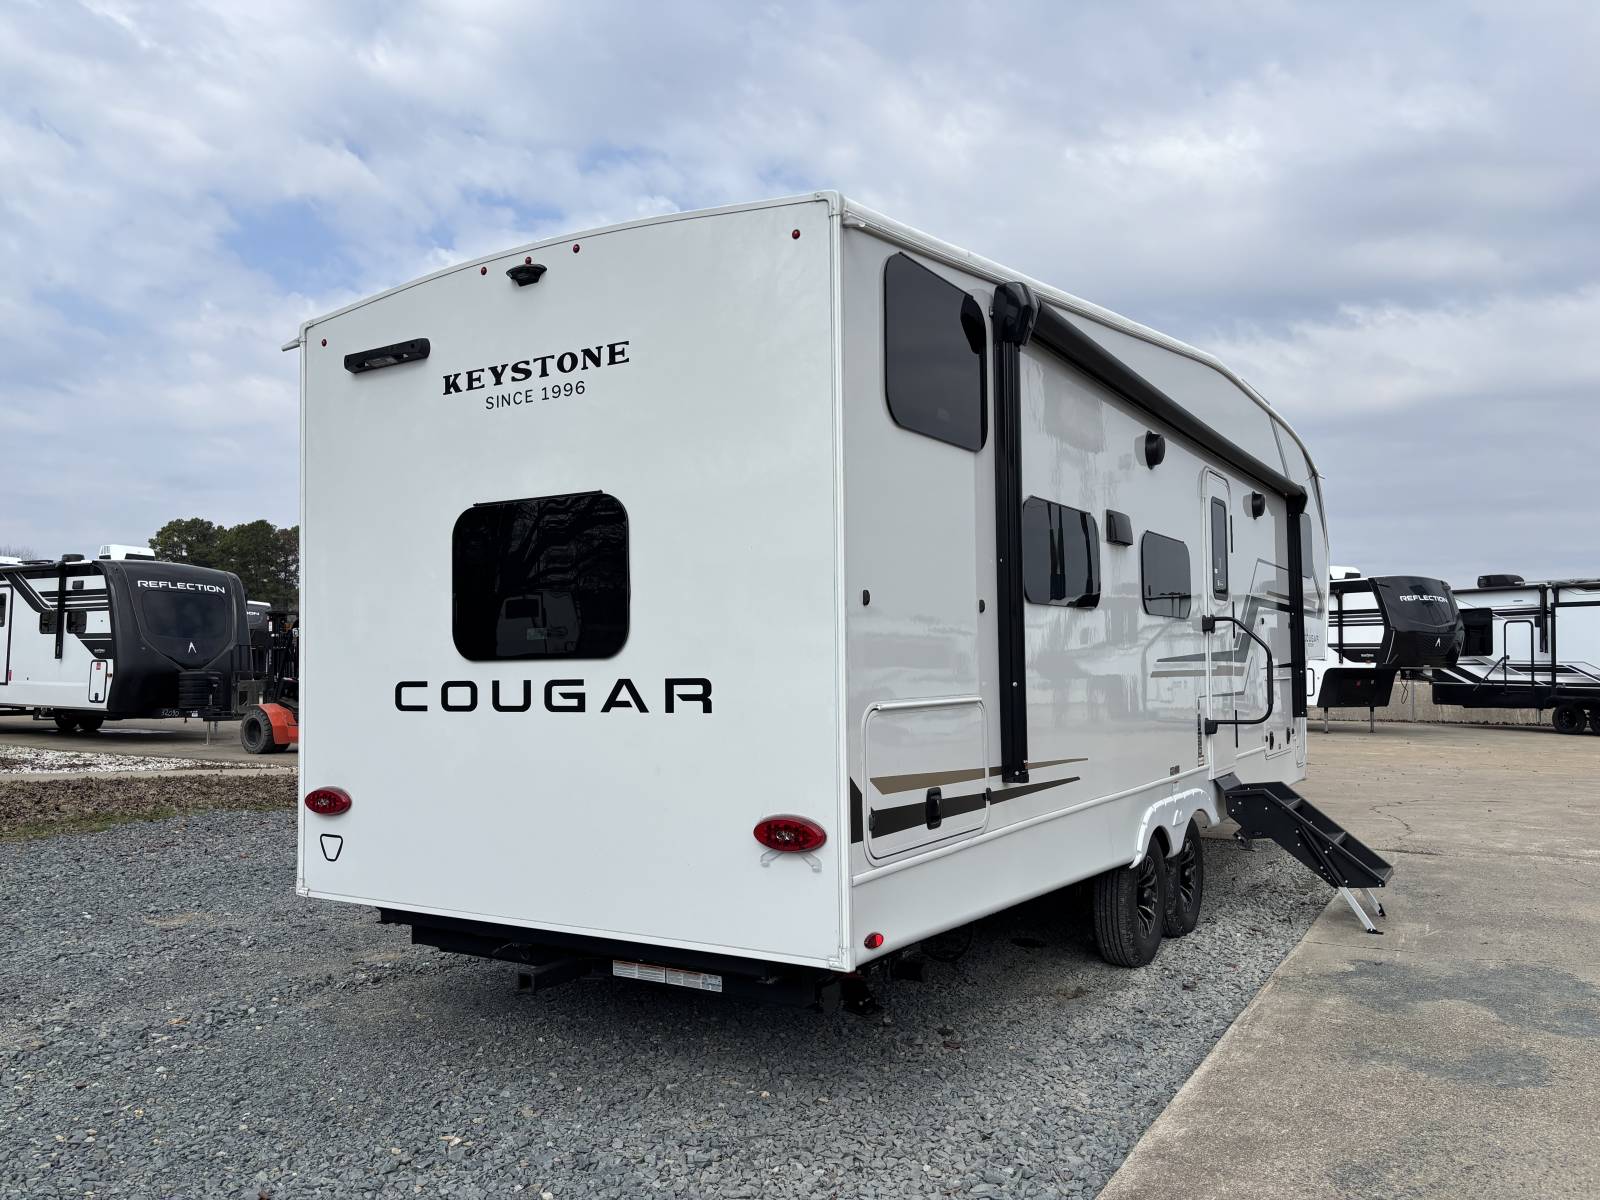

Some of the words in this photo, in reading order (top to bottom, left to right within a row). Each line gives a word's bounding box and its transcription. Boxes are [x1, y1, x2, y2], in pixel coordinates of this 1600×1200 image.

[442, 340, 630, 396] KEYSTONE
[485, 389, 534, 410] SINCE
[541, 380, 586, 401] 1996
[137, 580, 226, 594] REFLECTION
[1400, 595, 1448, 603] REFLECTION
[394, 677, 713, 714] COUGAR
